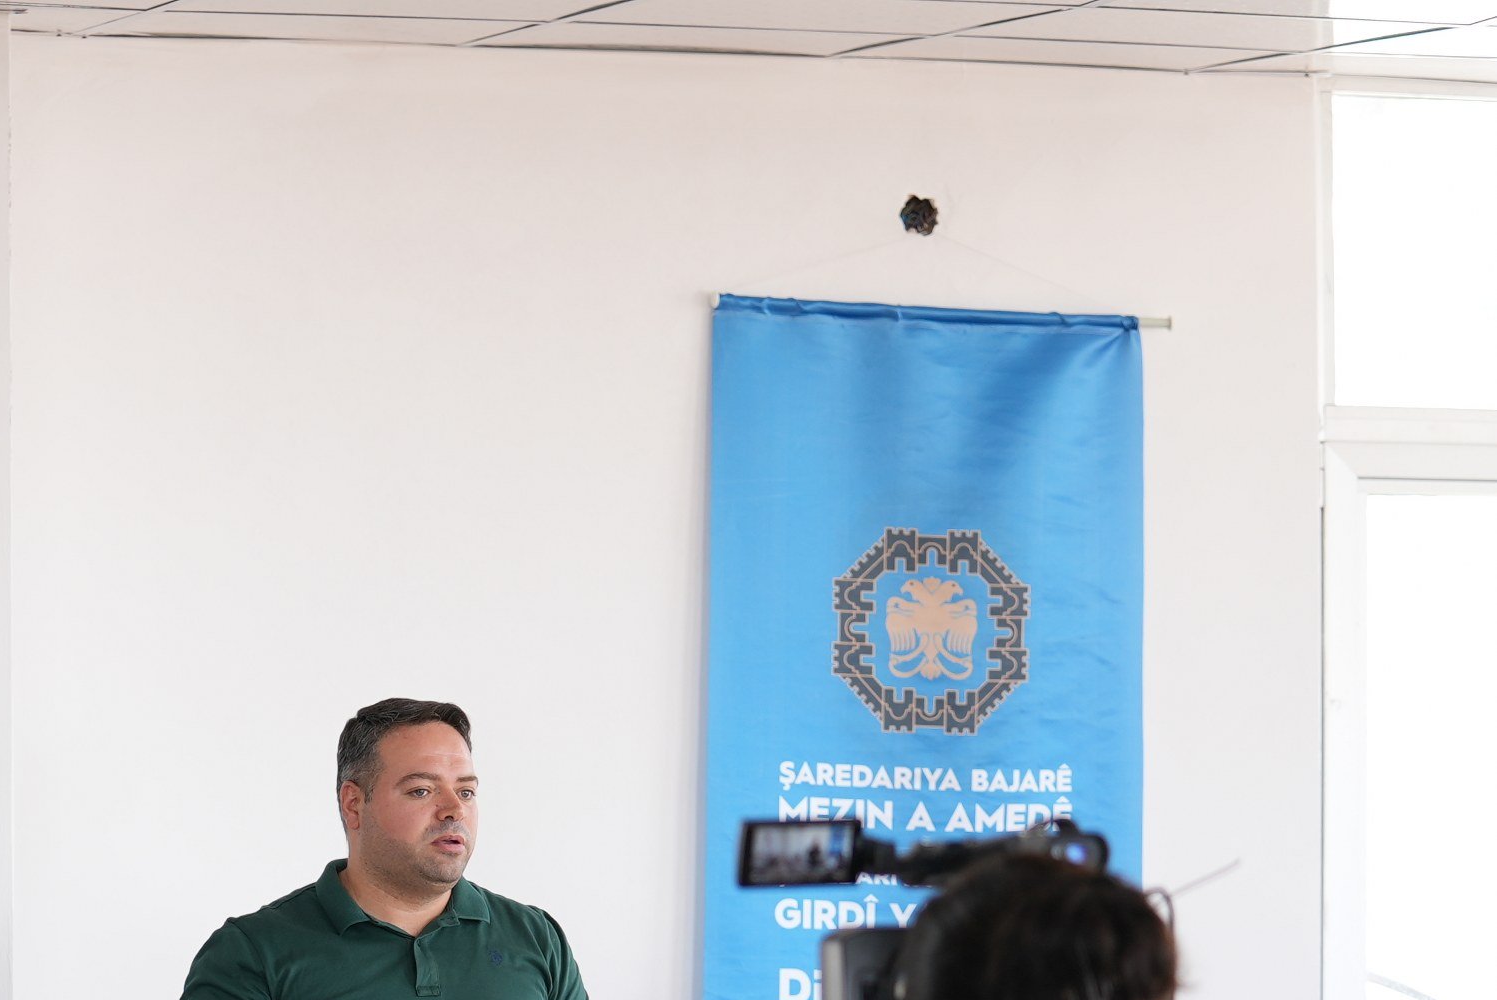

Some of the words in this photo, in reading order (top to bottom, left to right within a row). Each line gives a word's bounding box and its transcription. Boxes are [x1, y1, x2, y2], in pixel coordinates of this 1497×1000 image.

[778, 760, 962, 792] ŞAREDARIYA
[971, 763, 1073, 793] BAJARÊ
[778, 796, 894, 830] MEZIN
[906, 801, 936, 832] A
[774, 893, 879, 930] GIRDÎ
